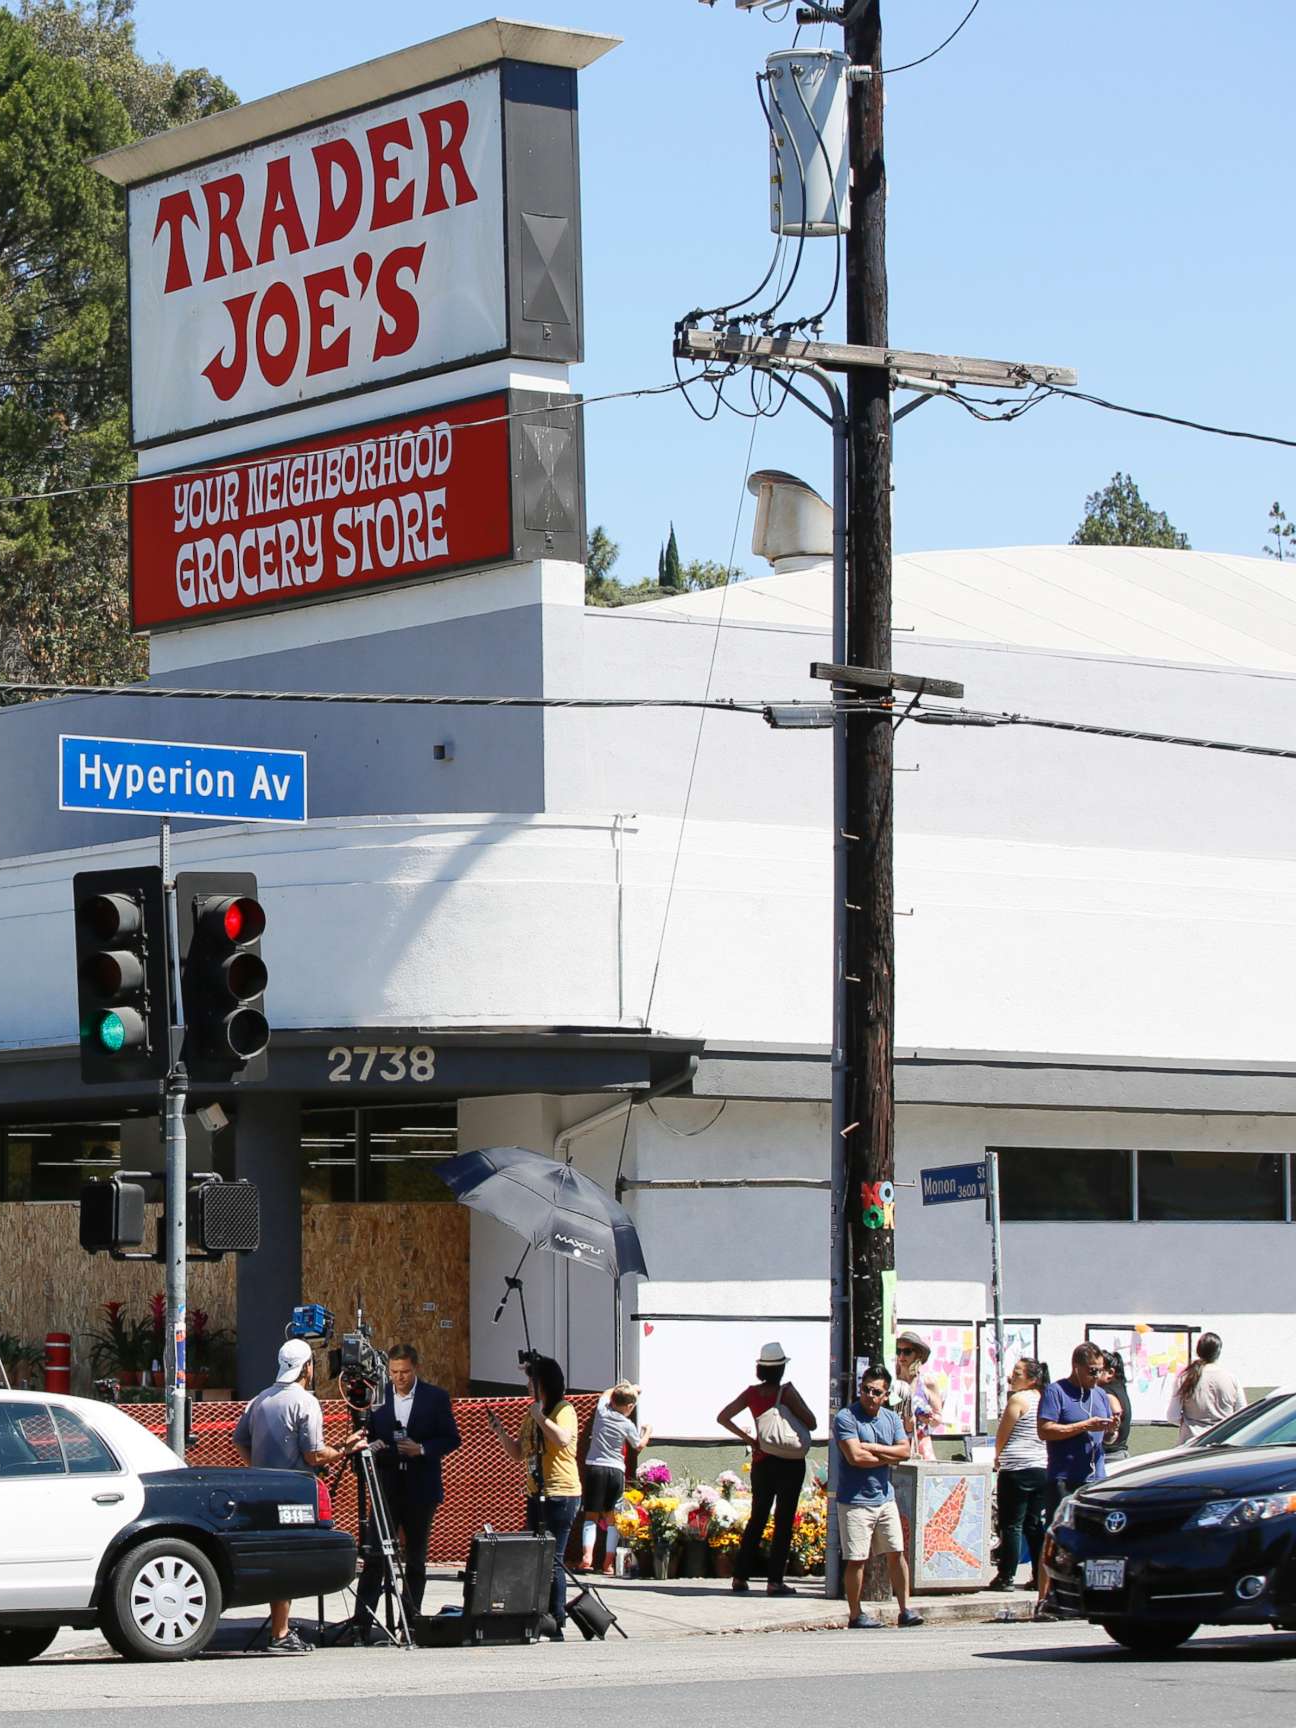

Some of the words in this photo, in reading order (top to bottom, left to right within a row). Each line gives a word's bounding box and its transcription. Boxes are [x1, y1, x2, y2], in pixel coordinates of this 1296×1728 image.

[152, 100, 478, 294] TRADER
[201, 241, 427, 402] JOE'S
[174, 471, 239, 533] YOUR
[246, 421, 452, 516] NEIGHBORHOOD
[176, 513, 324, 608] GROCERY
[333, 487, 448, 577] STORE
[79, 753, 234, 800] Hyperion
[249, 765, 290, 801] Av
[327, 1045, 435, 1082] 2738
[923, 1177, 956, 1196] Monon
[976, 1166, 986, 1179] St
[957, 1183, 977, 1198] 3600
